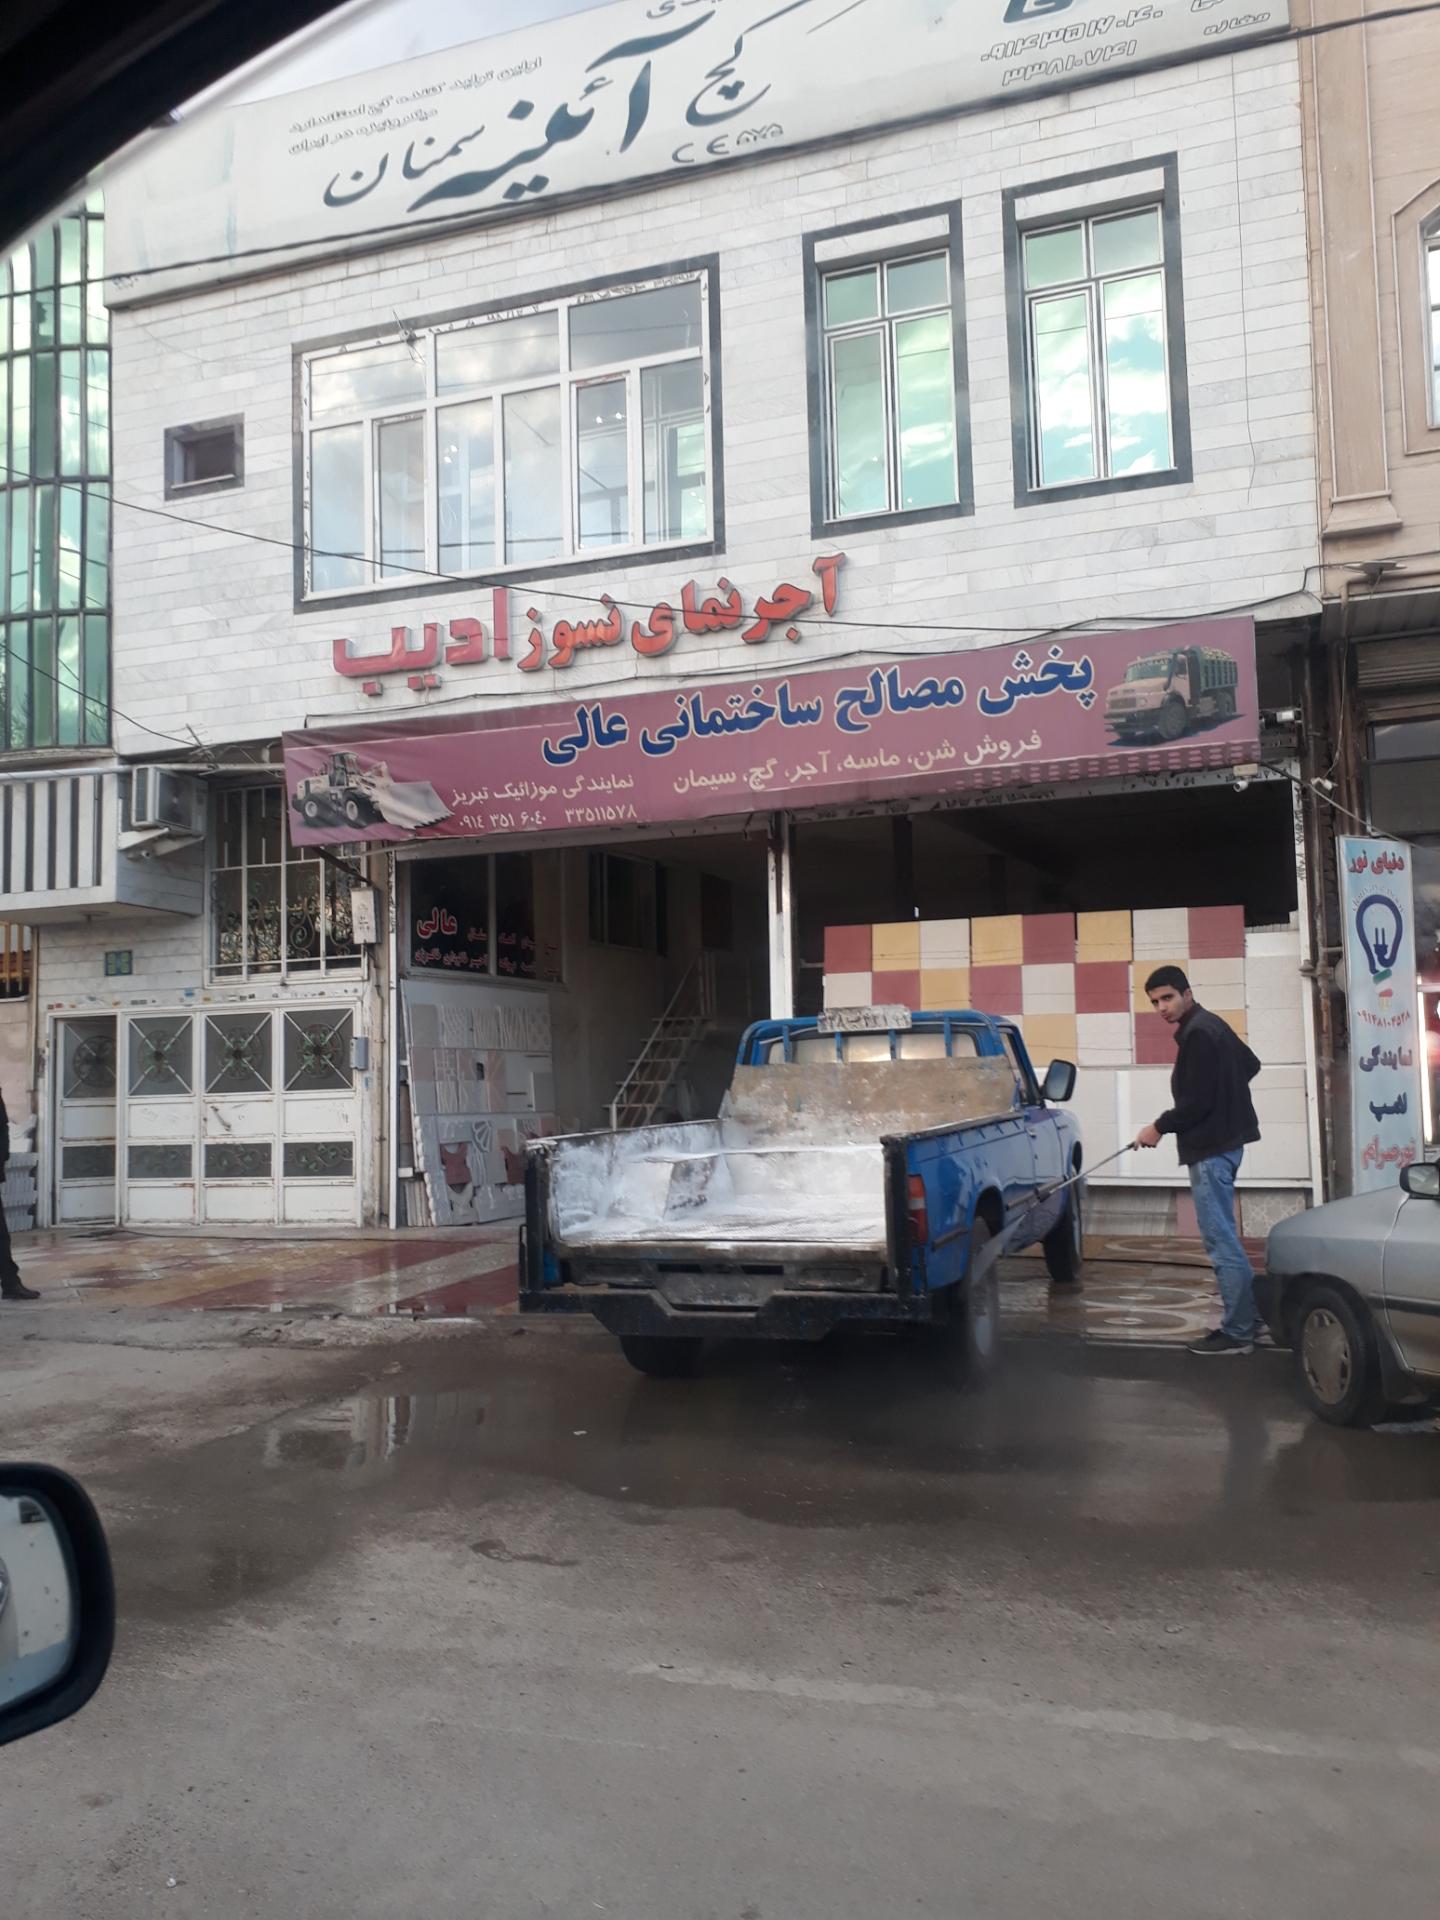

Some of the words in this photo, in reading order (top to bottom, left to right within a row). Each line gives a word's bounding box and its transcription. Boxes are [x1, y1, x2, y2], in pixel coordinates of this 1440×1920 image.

[322, 122, 486, 207] سمنان
[332, 587, 512, 697] ادیب
[517, 593, 624, 672] نسوز
[976, 644, 1097, 717] پخش
[833, 664, 966, 735] مصالح
[541, 702, 630, 767] عالی
[639, 679, 824, 758] ساختمانی
[962, 728, 1043, 765] فروش
[451, 786, 489, 807] تبریز
[562, 773, 634, 800] نمایندگی
[672, 768, 737, 794] سیمان
[564, 803, 638, 824] ۳۳۵۱۱۵۷۸
[1347, 848, 1369, 874] نور
[1371, 850, 1405, 876] دنیای
[416, 906, 458, 940] عالی
[1358, 1044, 1413, 1073] نمایندگی
[1369, 1091, 1408, 1123] لامپ
